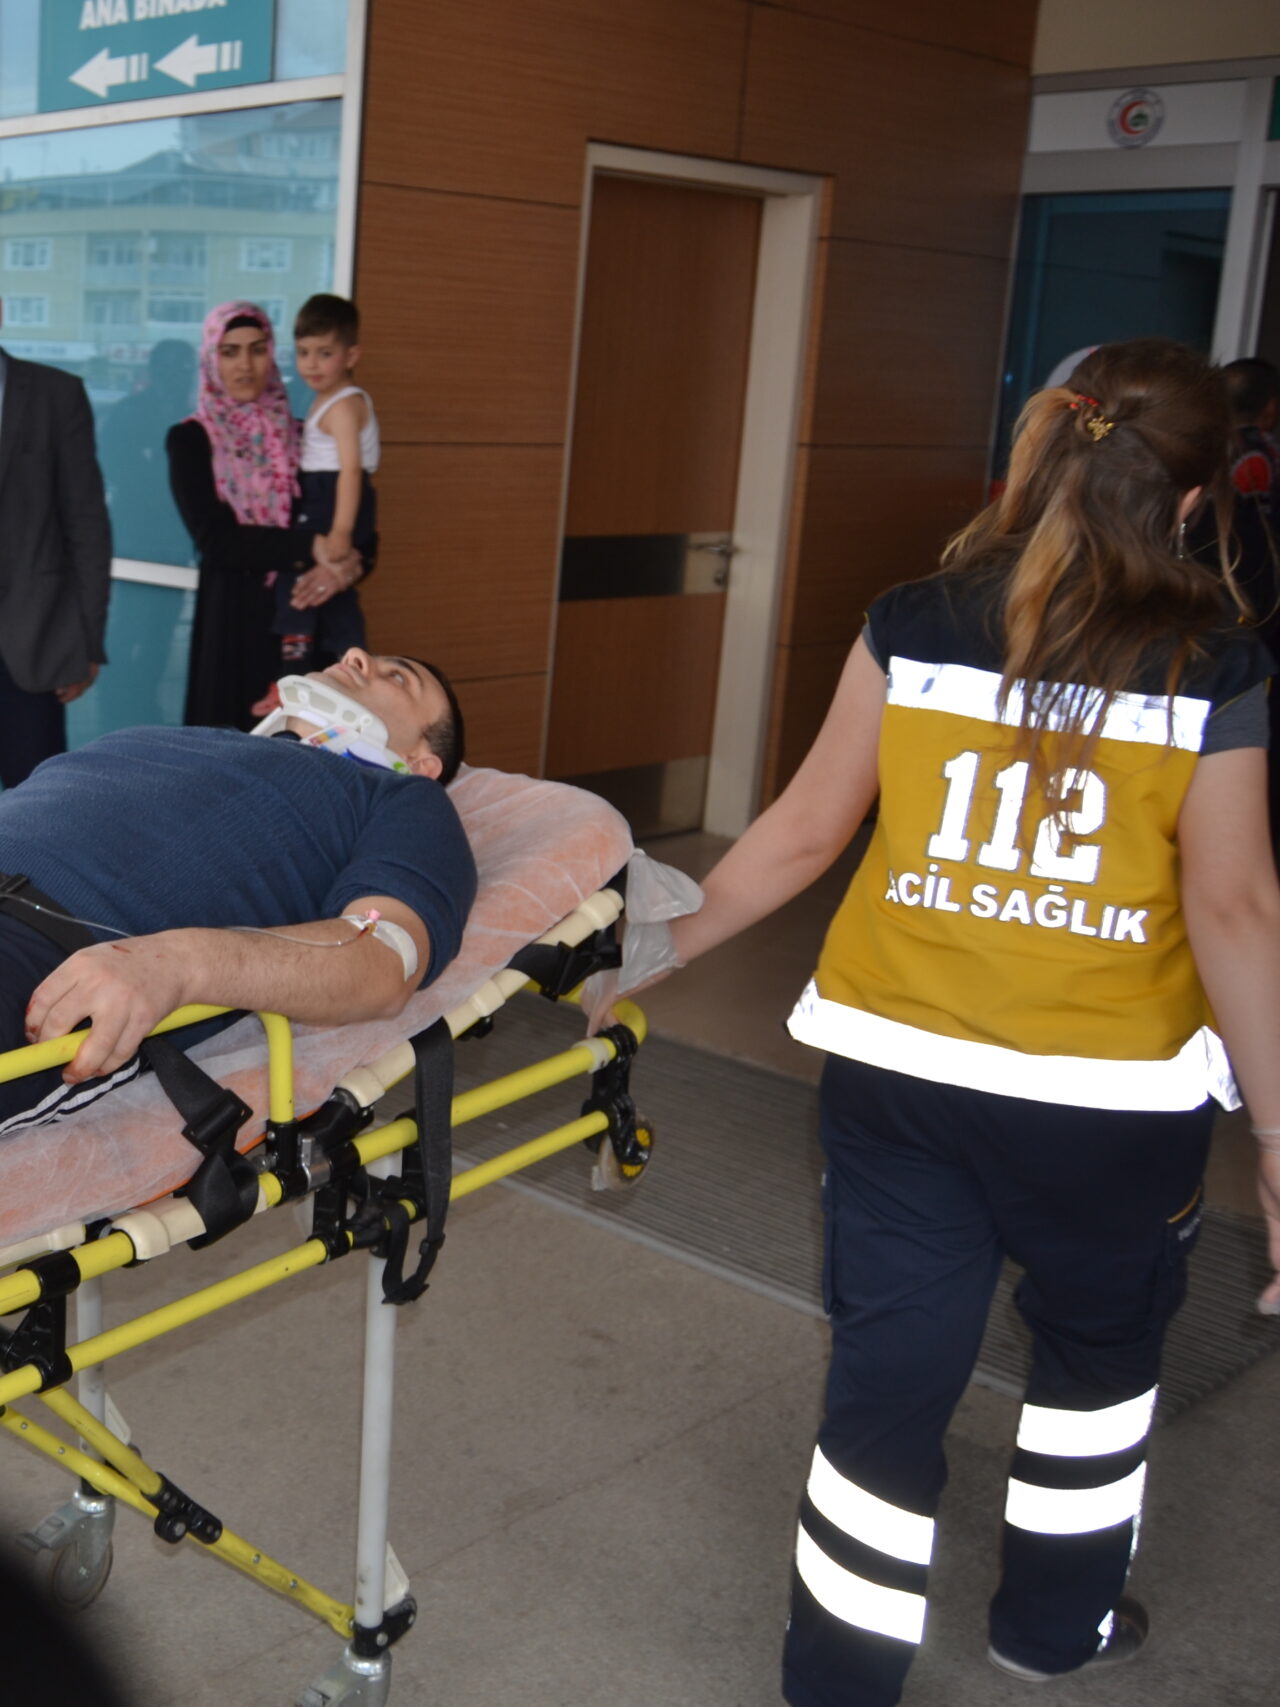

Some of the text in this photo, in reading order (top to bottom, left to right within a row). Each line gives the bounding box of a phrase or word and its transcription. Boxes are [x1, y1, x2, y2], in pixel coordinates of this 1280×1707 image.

[79, 0, 129, 30] ANA
[928, 750, 1107, 883] 112
[970, 885, 1149, 943] SAĞLIK
